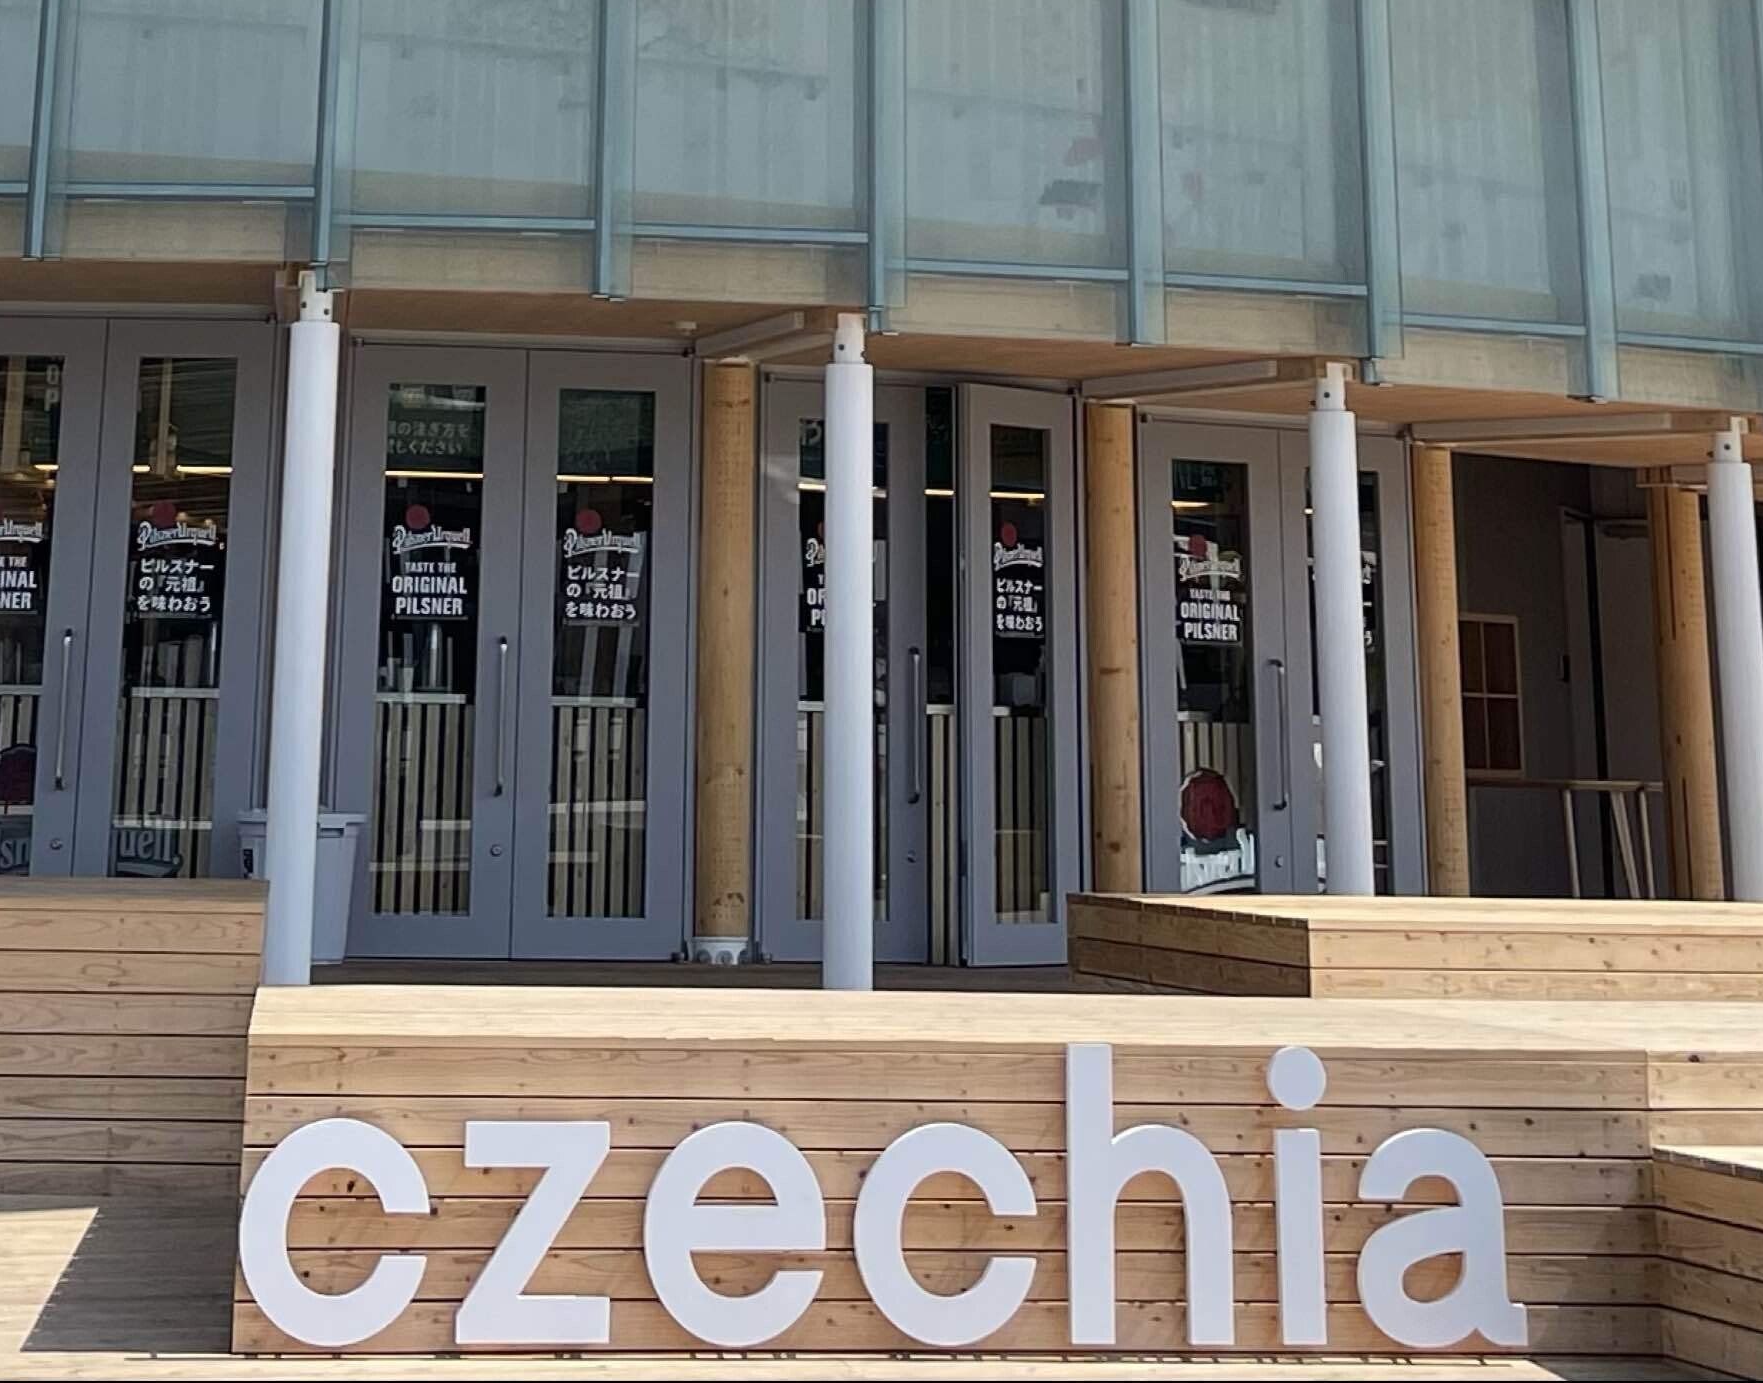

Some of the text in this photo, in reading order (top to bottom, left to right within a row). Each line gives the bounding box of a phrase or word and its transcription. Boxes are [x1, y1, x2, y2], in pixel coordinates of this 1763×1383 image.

[392, 576, 467, 594] ORIGINAL
[137, 596, 211, 612] を味わおう
[395, 597, 462, 615] PILSNER
[565, 603, 636, 619] を味わおう
[1180, 602, 1240, 621] ORIGINAL
[1184, 622, 1237, 641] PILSNER
[238, 1042, 1529, 1349] czechia
